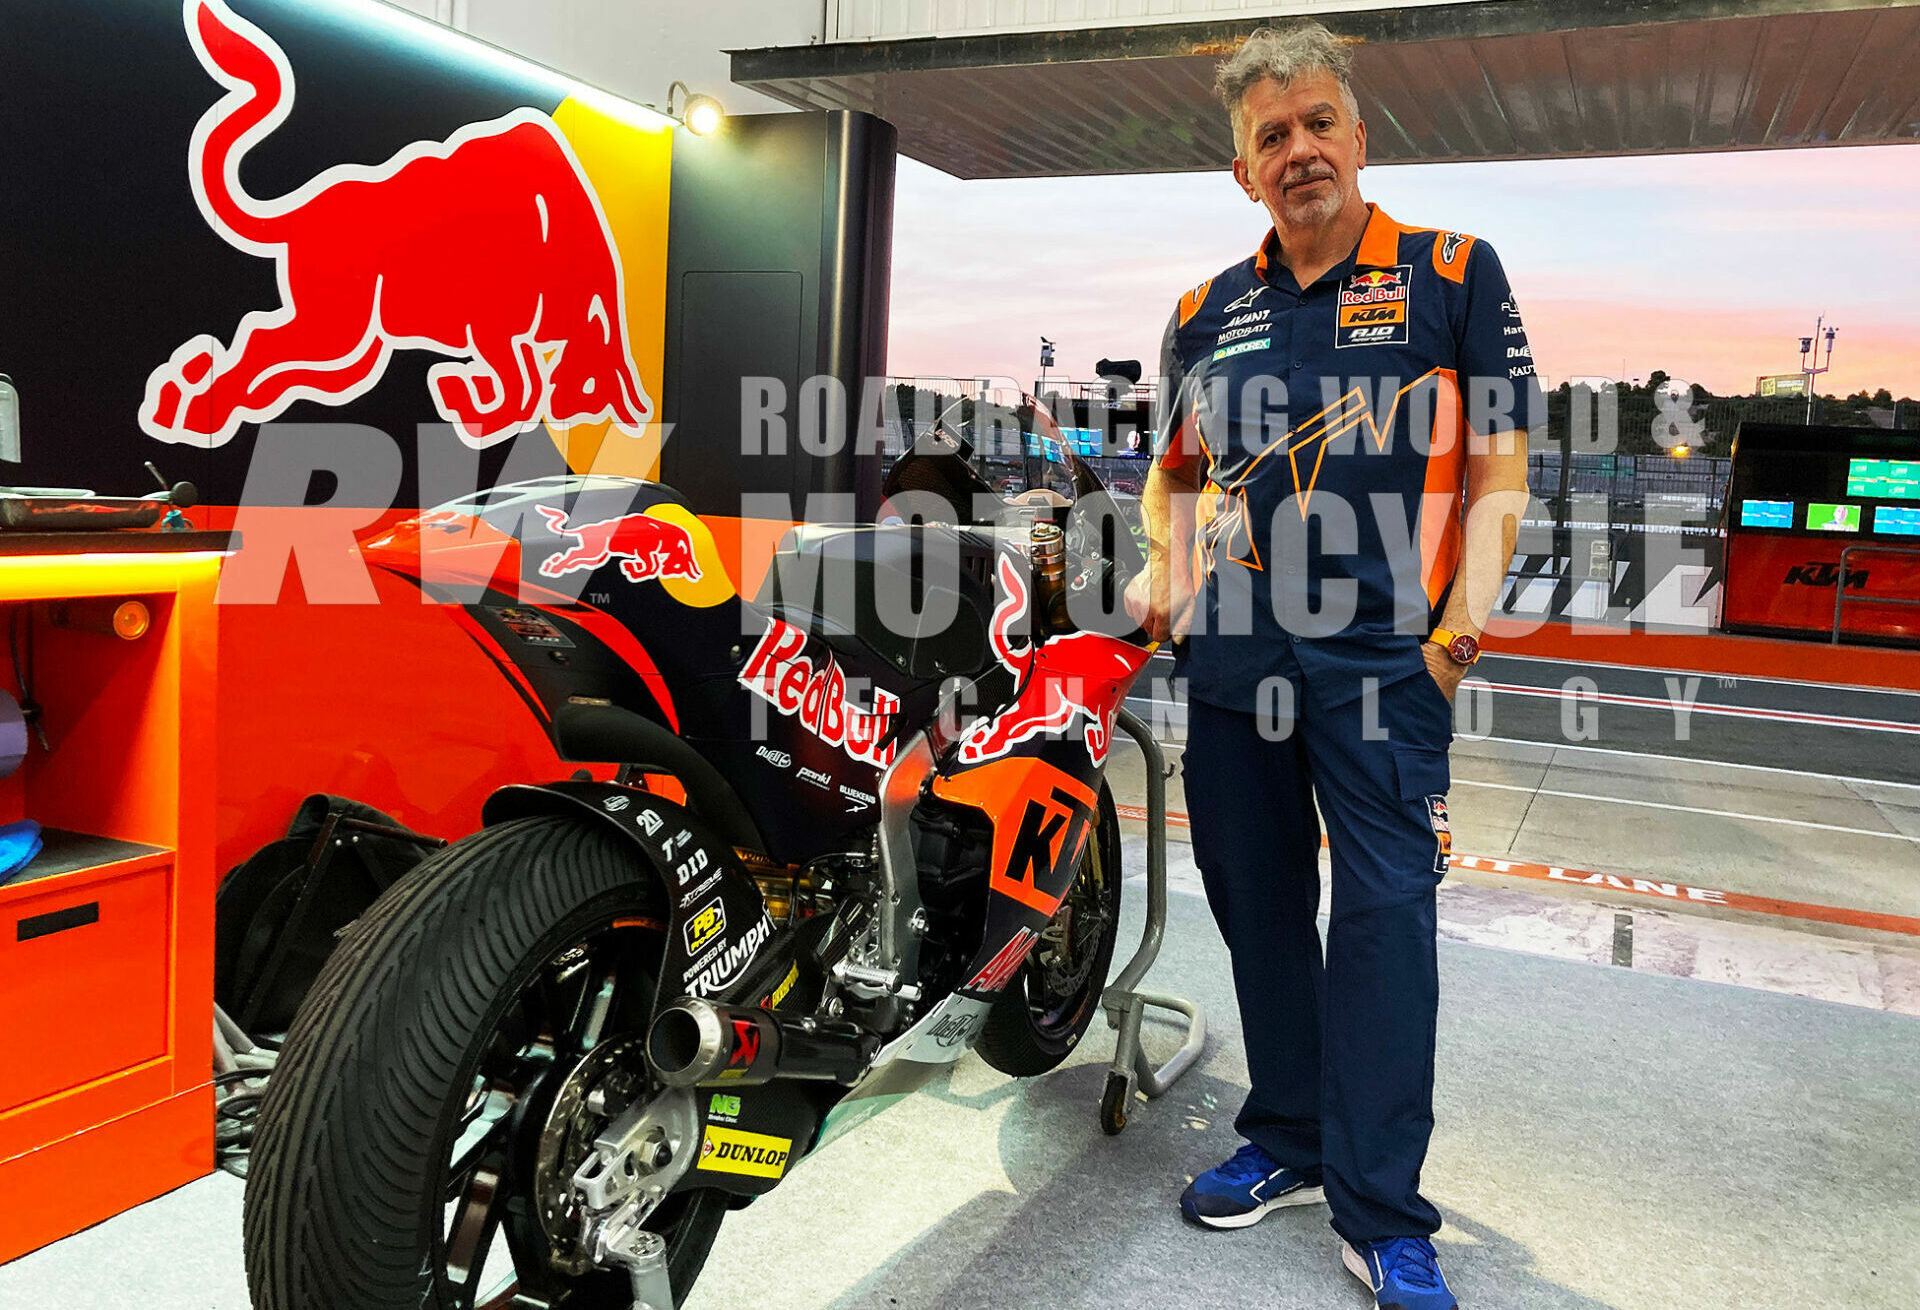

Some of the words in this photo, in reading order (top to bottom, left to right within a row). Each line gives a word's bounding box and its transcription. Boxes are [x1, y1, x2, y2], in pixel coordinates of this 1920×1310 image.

[1341, 286, 1374, 306] Red
[1374, 285, 1406, 302] Bull
[1221, 309, 1271, 330] AVANT
[1348, 307, 1397, 323] KTM
[1217, 323, 1273, 346] MOTOBATT
[1226, 338, 1268, 356] MOTOREX
[1784, 562, 1869, 588] KTM
[737, 617, 833, 735] Red
[819, 659, 900, 770] Bull
[1005, 785, 1095, 900] KT
[676, 848, 708, 886] DID
[1449, 854, 1523, 873] IT
[1548, 867, 1728, 904] LANE
[693, 906, 715, 939] PB
[683, 946, 718, 983] POWERED
[717, 937, 727, 953] BY
[685, 914, 771, 998] TRIUMPH
[716, 1142, 788, 1166] DUNLOP
